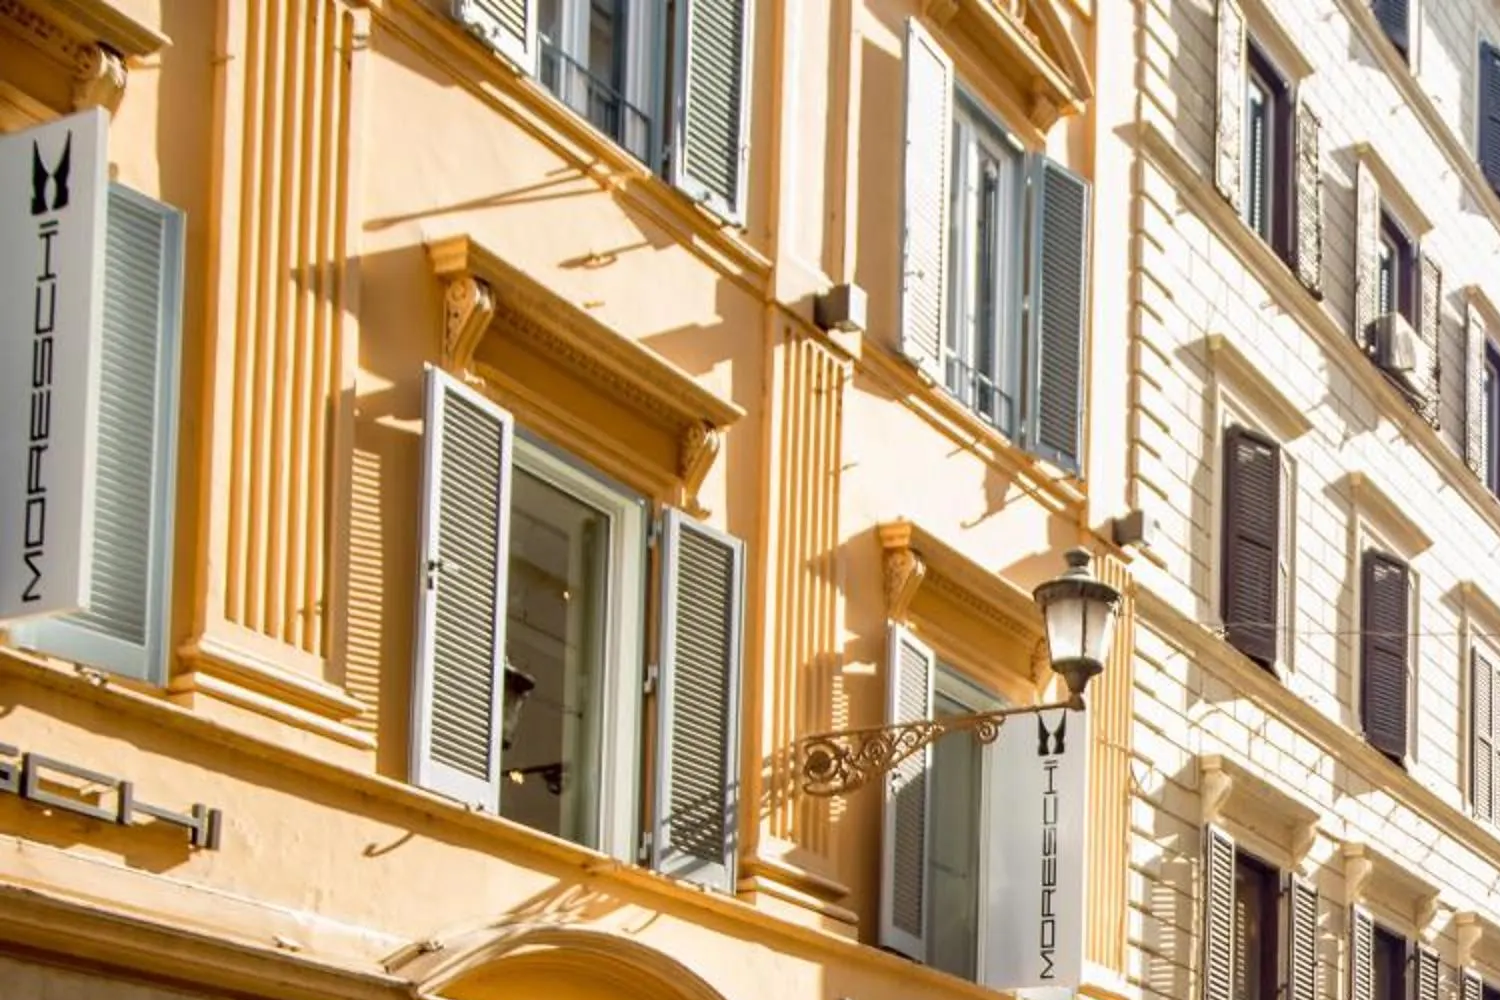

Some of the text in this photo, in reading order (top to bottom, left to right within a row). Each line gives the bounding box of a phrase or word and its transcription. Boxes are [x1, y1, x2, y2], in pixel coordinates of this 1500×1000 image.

[21, 219, 60, 602] MORESCHI
[0, 741, 222, 851] CHI
[1039, 758, 1059, 980] MORESCHI
